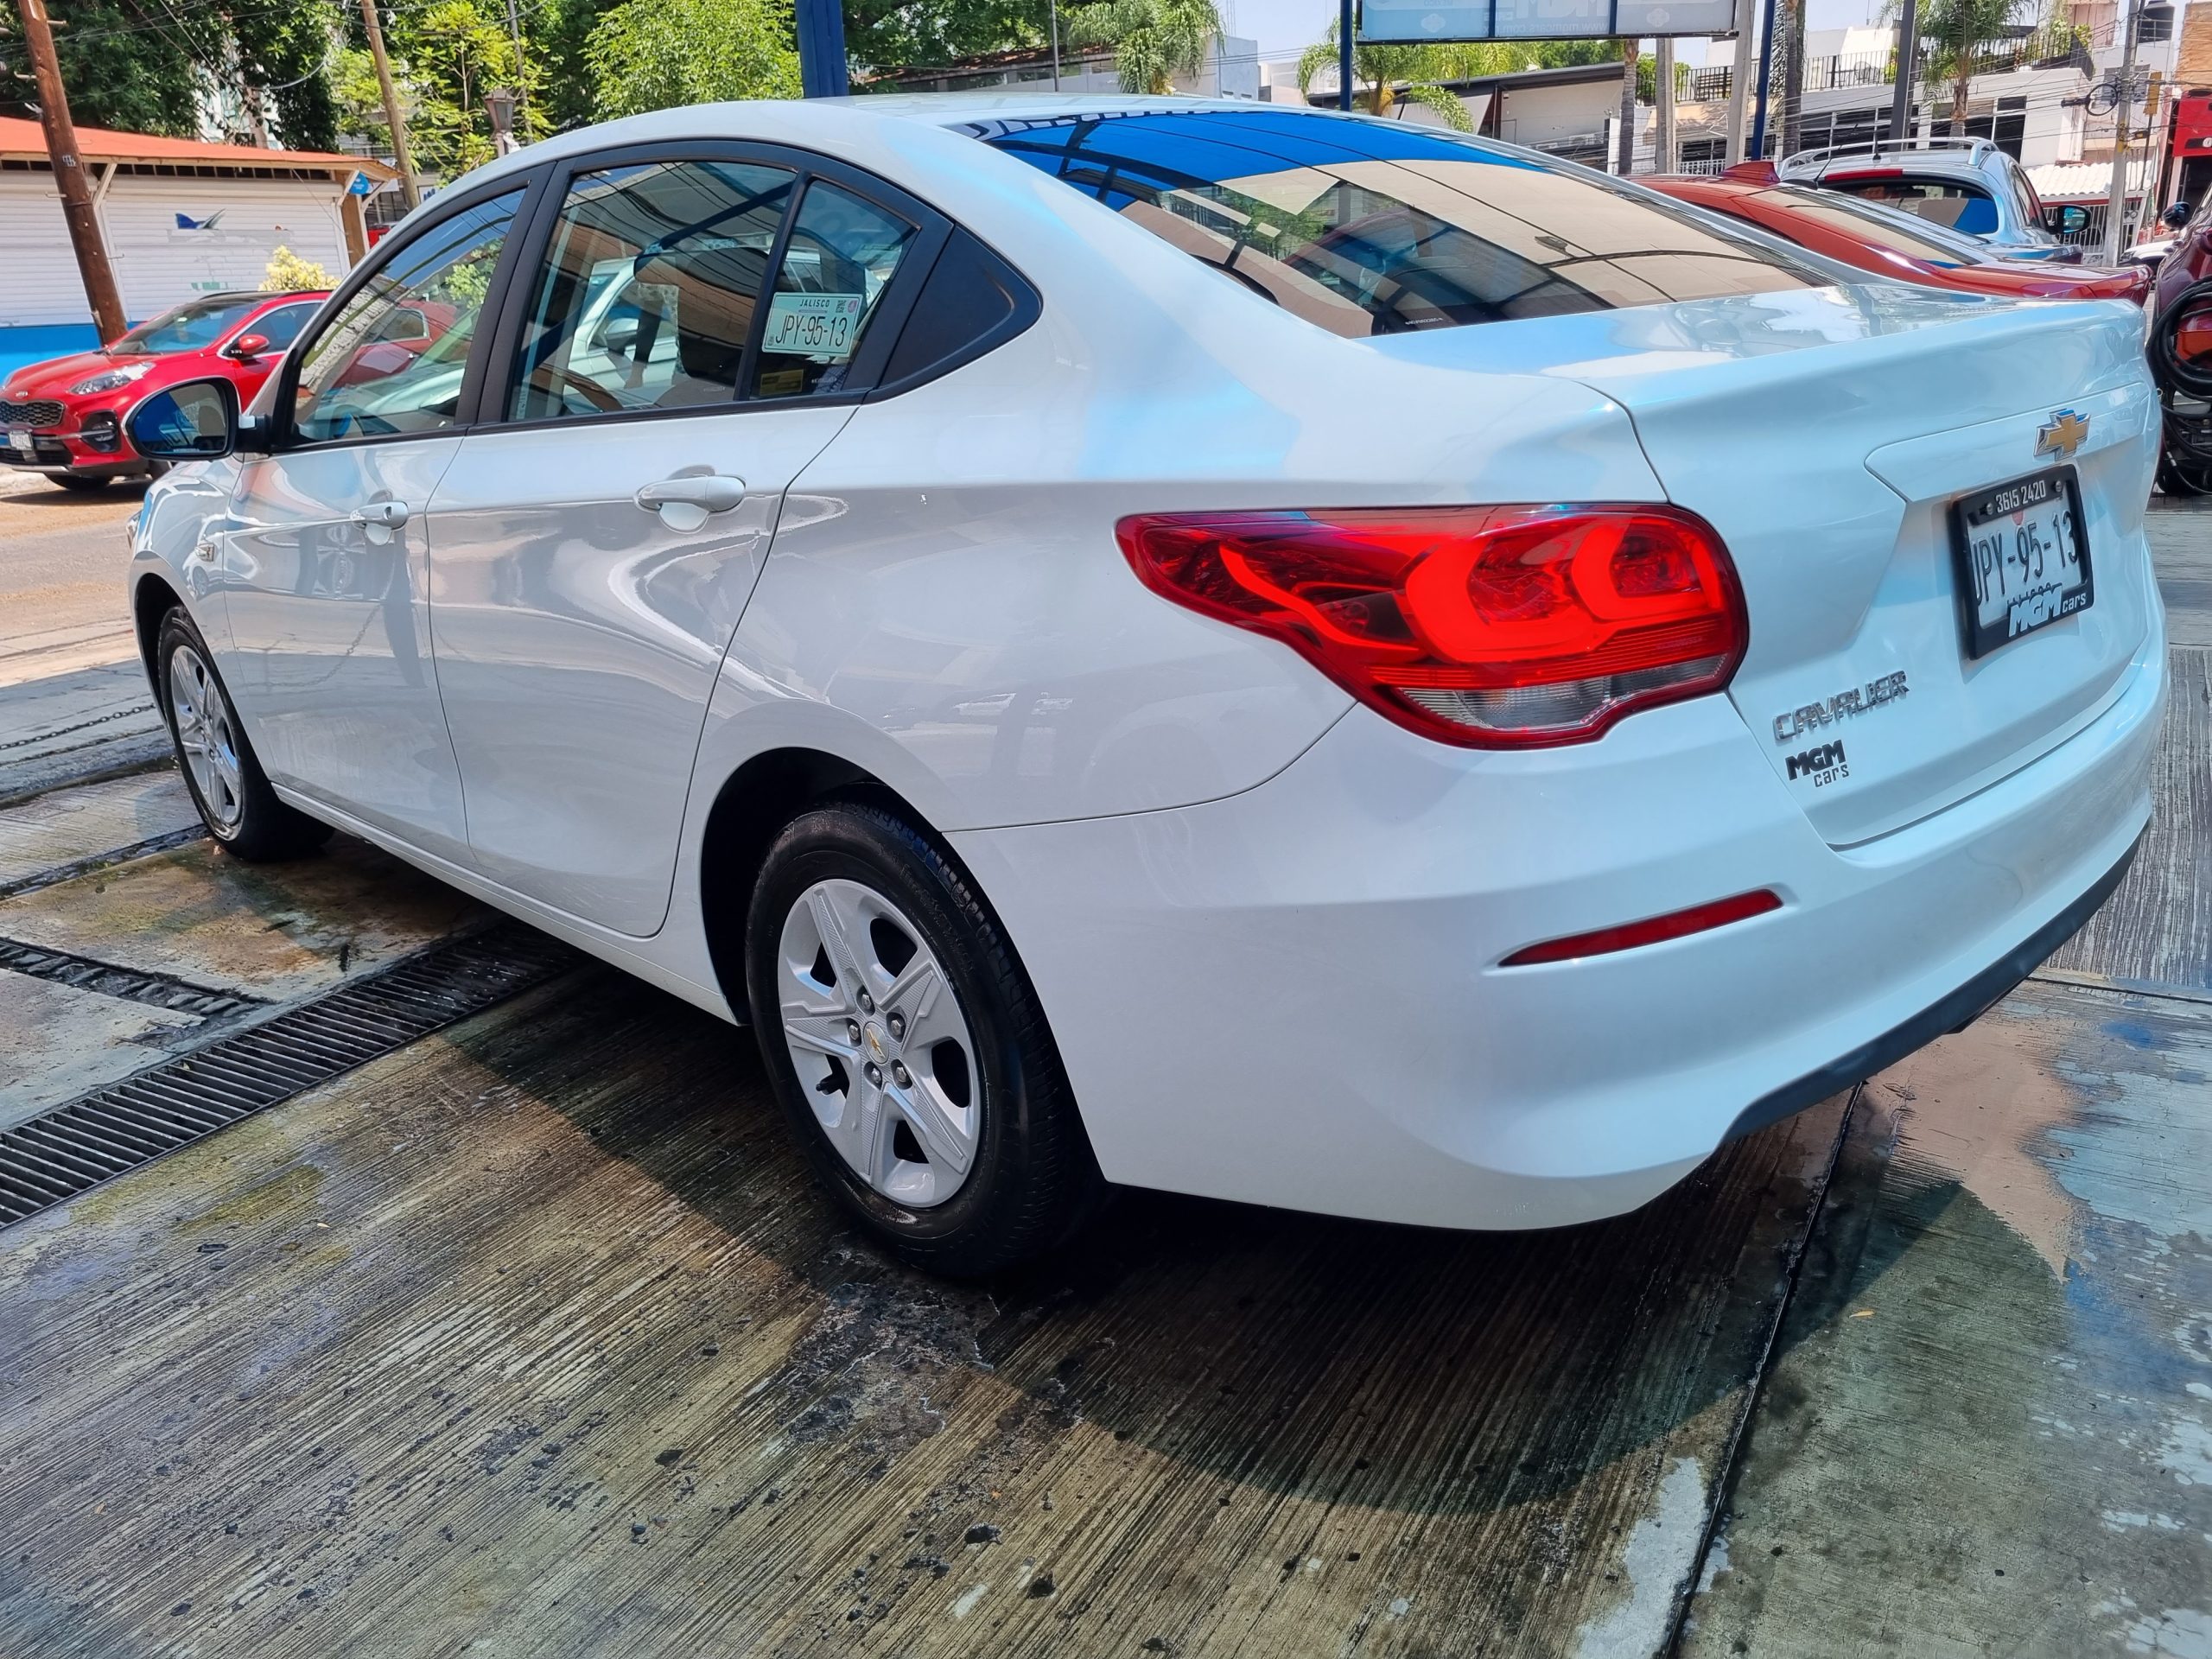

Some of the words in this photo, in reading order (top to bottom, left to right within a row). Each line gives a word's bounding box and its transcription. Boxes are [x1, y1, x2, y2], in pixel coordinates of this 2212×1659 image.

[799, 299, 830, 308] JALISCO
[775, 315, 848, 347] JPY-95-13
[1995, 488, 2019, 513] 3615
[2021, 480, 2047, 505] 2420
[1971, 510, 2078, 607] JPY-95-13
[2008, 585, 2063, 638] MGM
[2062, 593, 2087, 614] cars
[1772, 670, 1910, 741] CAVALIER
[1785, 739, 1847, 781] MGM
[1814, 764, 1850, 788] cars
